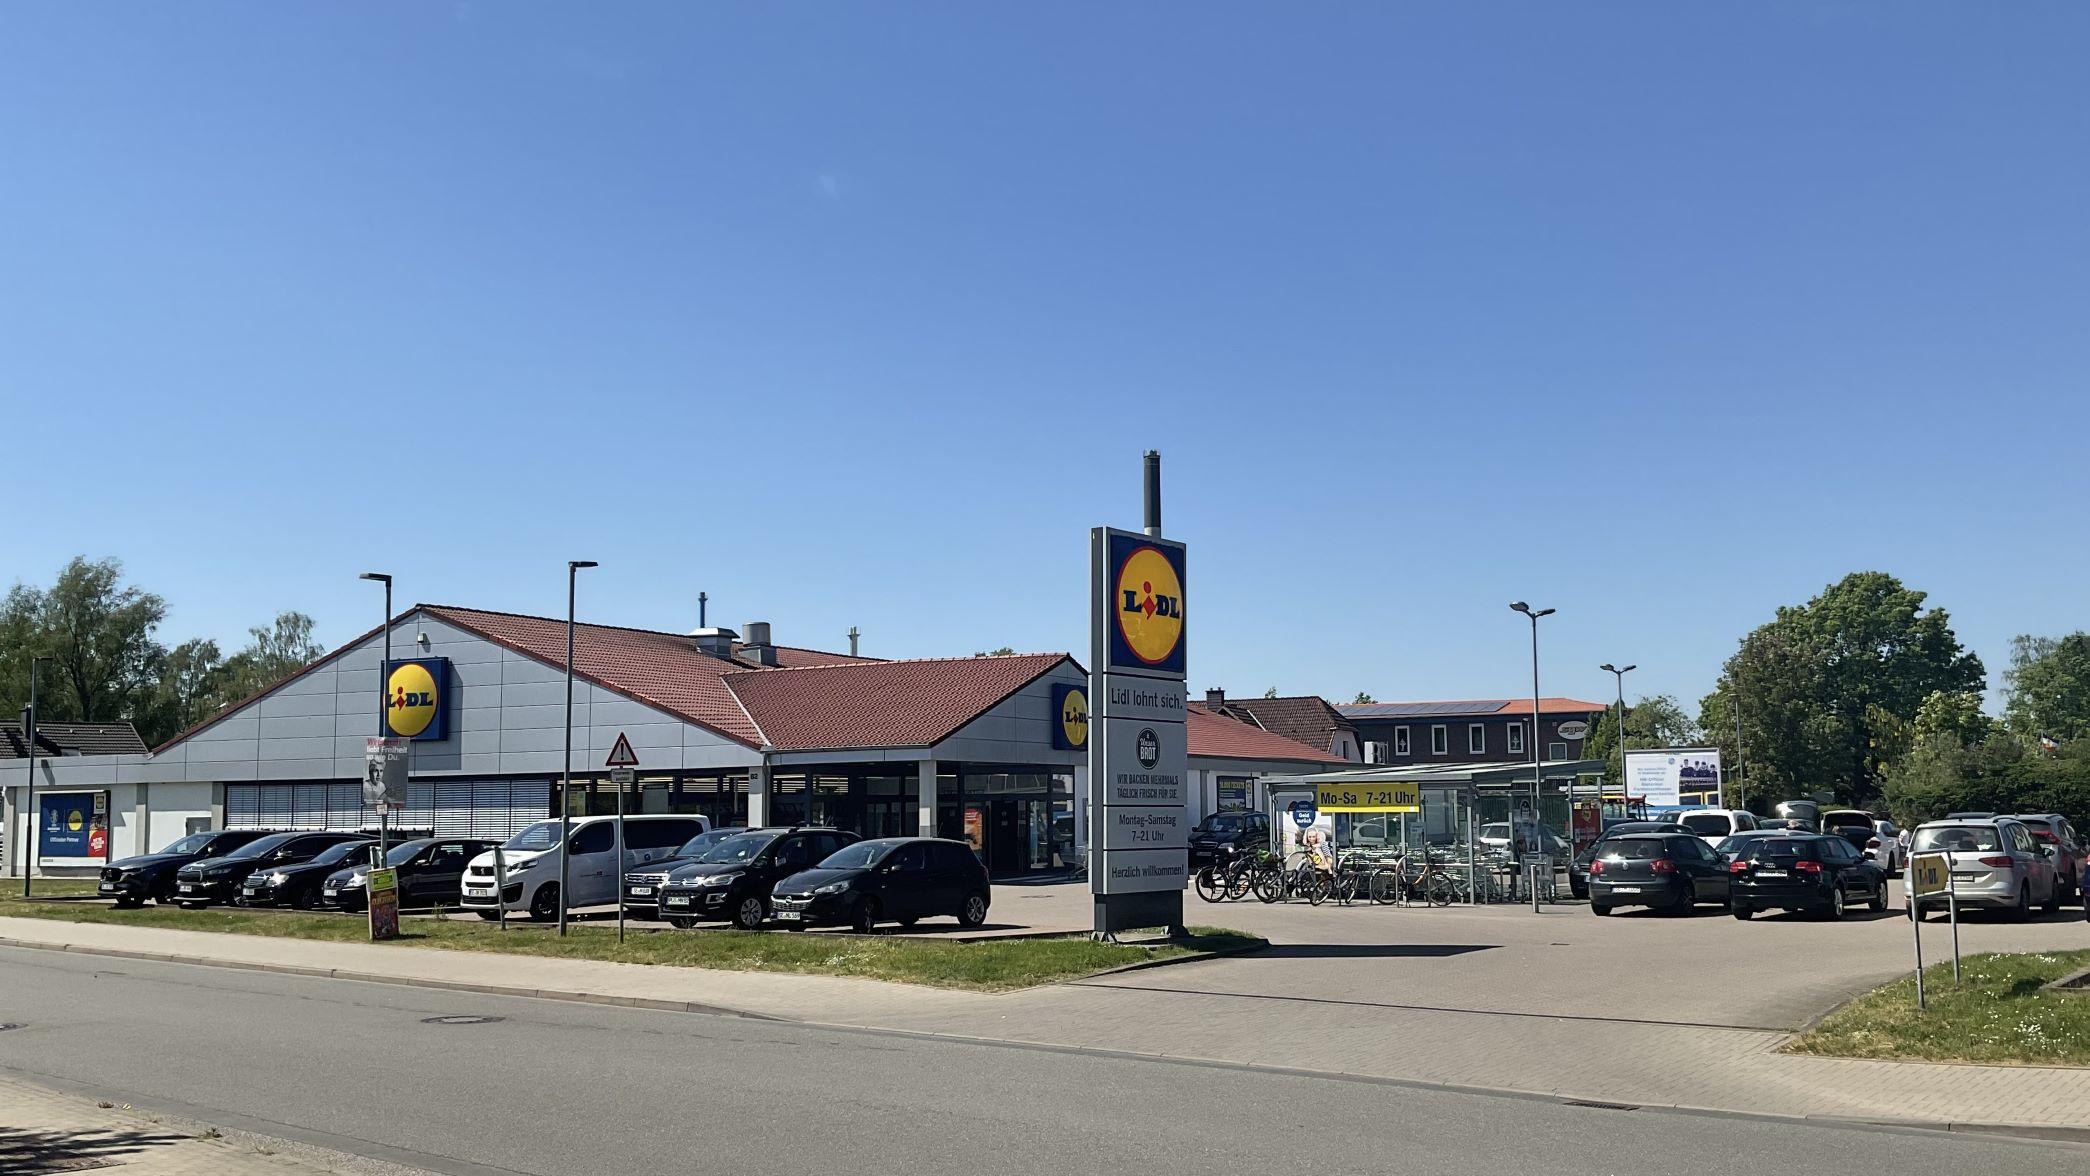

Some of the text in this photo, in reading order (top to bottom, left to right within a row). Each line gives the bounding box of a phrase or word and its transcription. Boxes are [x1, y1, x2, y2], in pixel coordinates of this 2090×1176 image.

[1111, 688, 1183, 710] Lidl lohnt sich.
[382, 745, 408, 754] Freiheit
[1140, 746, 1156, 760] BROT
[1117, 773, 1128, 784] WIR
[1129, 774, 1149, 785] BACKEN
[1139, 788, 1157, 799] FRISCH
[1320, 791, 1415, 804] Mo-Sa 7-21 Uhr
[1152, 830, 1165, 841] Uhr
[1112, 864, 1184, 879] Herzlich willkommen!
